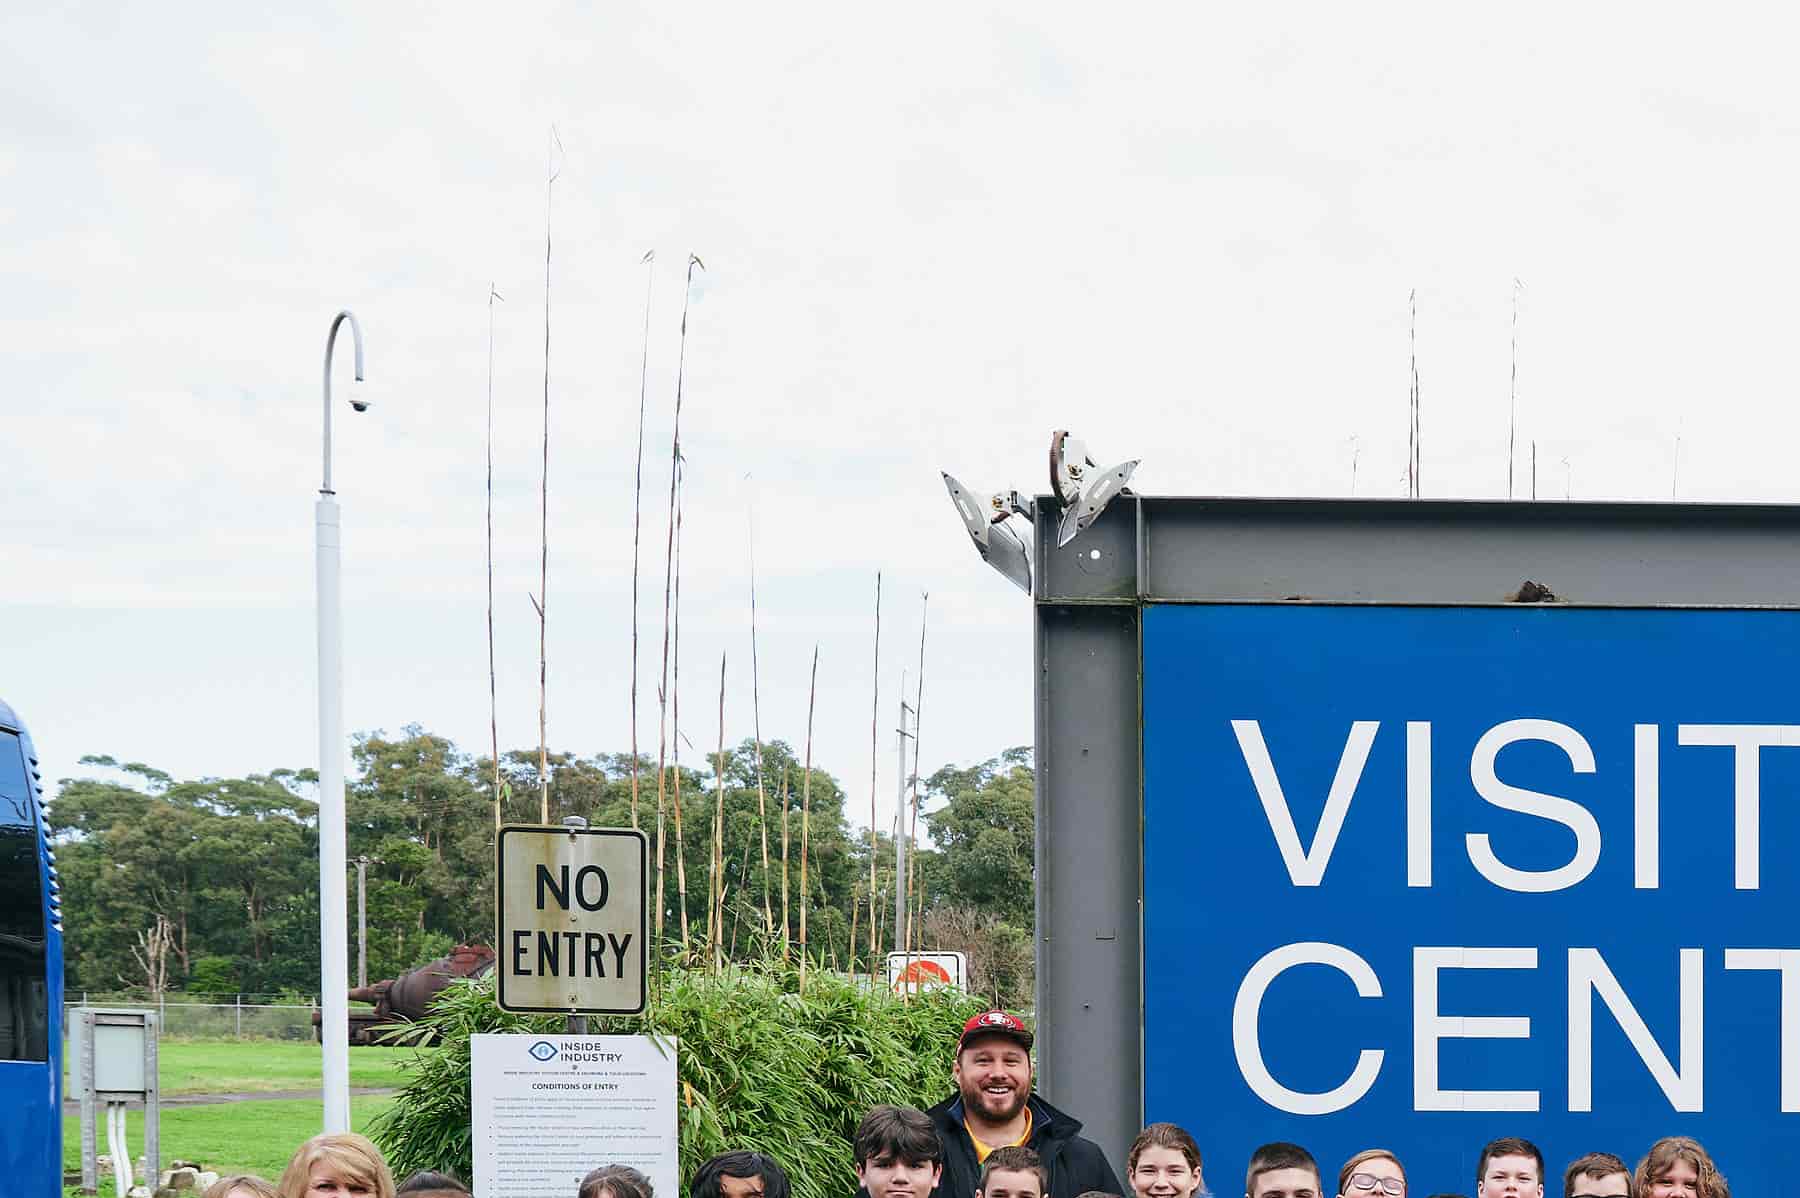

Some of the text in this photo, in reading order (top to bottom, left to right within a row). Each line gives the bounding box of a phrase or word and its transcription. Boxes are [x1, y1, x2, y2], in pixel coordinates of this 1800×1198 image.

[537, 864, 608, 911] NO
[513, 931, 632, 978] ENTRY
[560, 1042, 601, 1051] INSIDE
[560, 1053, 622, 1062] INDUSTRY
[532, 1082, 618, 1090] CONDITIONS OF ENTRY
